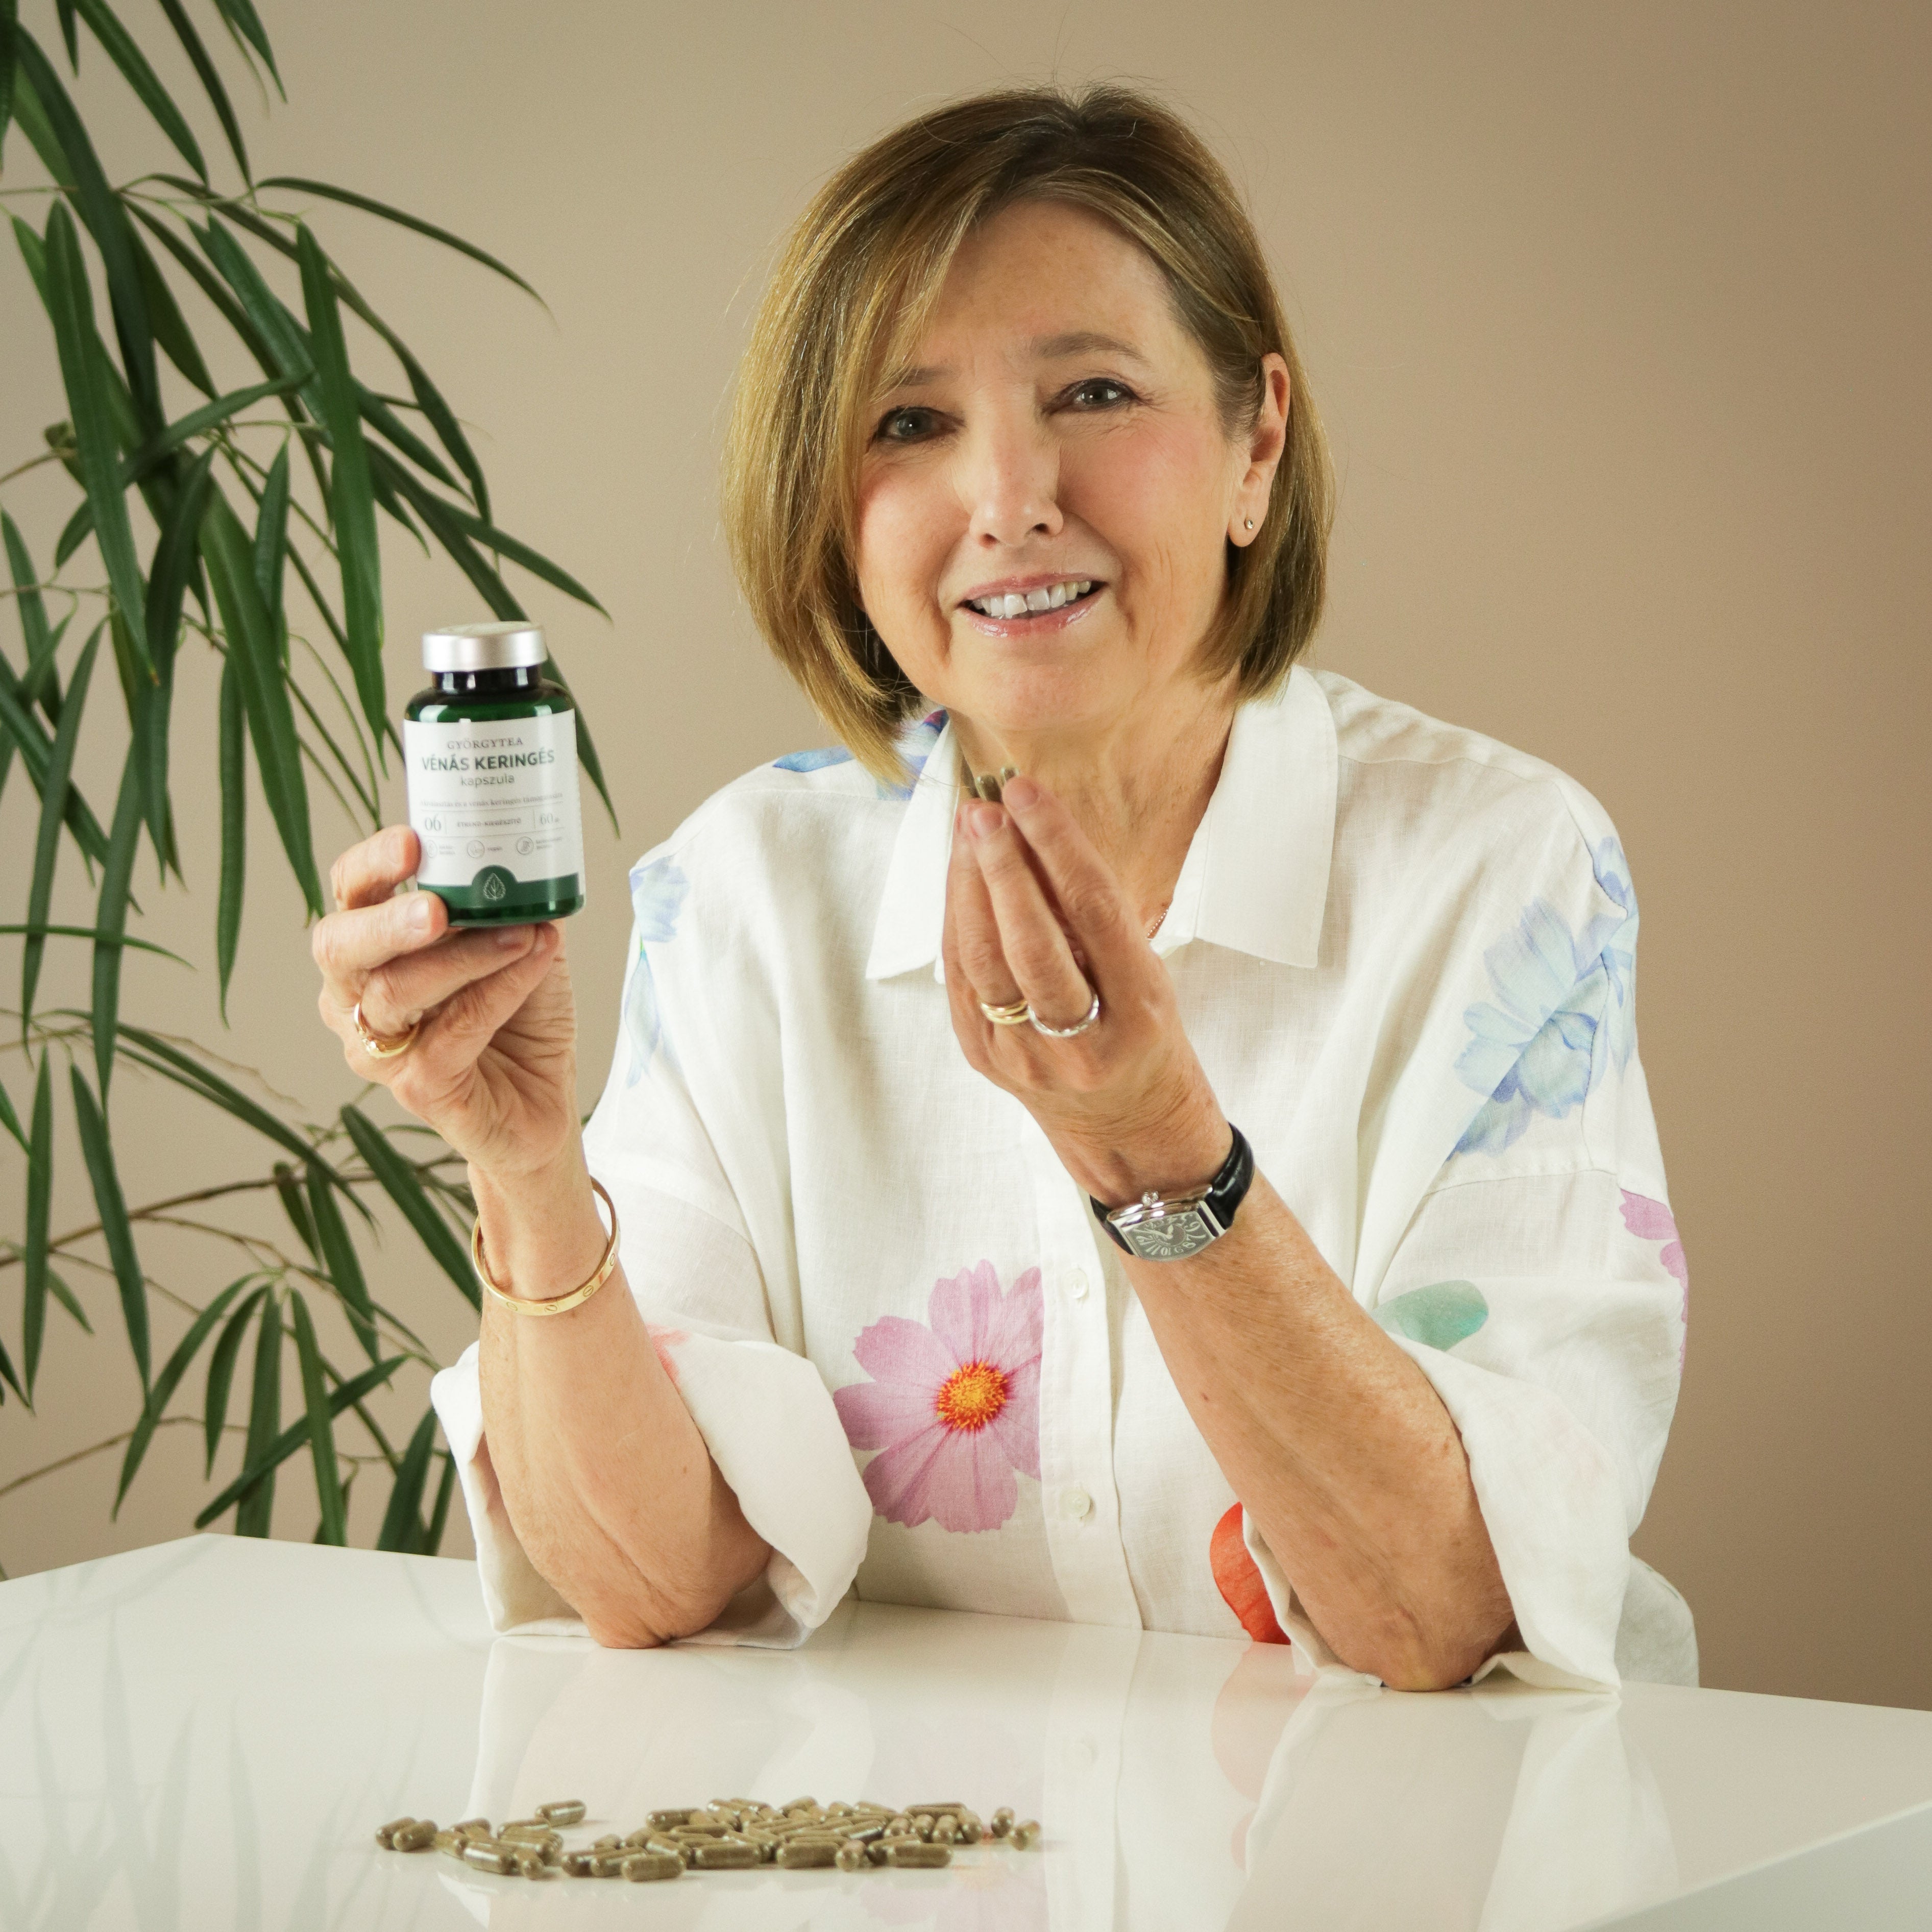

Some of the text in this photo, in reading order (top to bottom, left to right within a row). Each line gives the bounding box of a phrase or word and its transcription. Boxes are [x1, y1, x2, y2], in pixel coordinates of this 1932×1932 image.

[448, 737, 523, 749] GYÖRGYTEA
[422, 747, 554, 770] VÉNÁS KERINGÉS
[461, 773, 515, 788] kapszula
[425, 813, 442, 832] 06
